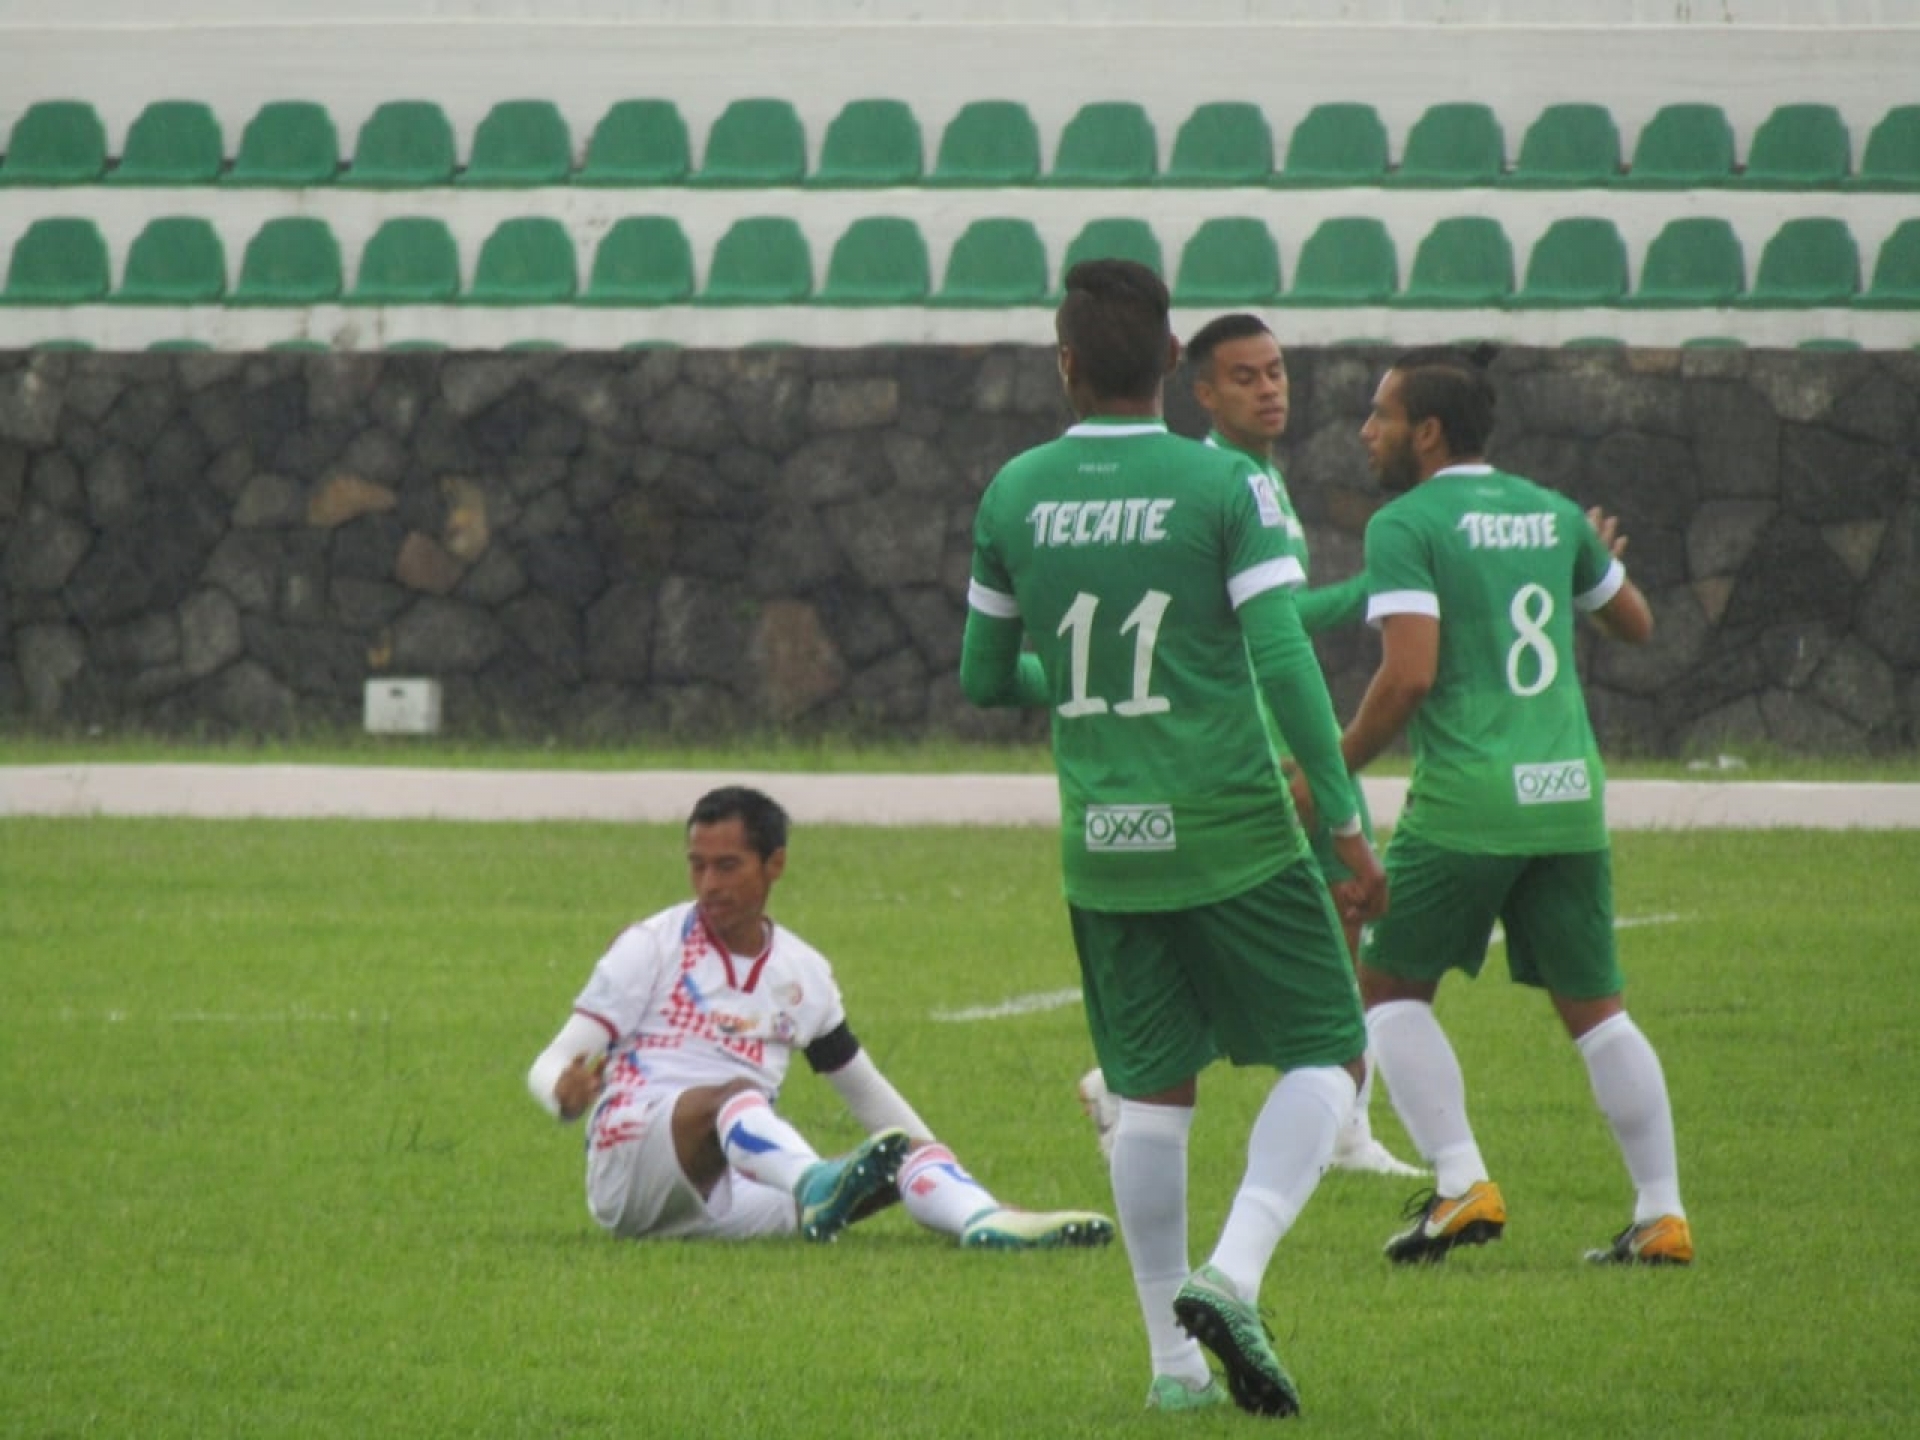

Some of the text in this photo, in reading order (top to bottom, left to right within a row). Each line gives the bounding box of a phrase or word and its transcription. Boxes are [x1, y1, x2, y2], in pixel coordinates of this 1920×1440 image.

[1026, 498, 1176, 547] TECATE
[1457, 512, 1560, 550] TECATE
[1056, 590, 1172, 718] 11
[1507, 583, 1557, 696] 8
[1518, 765, 1587, 799] OXXO
[1089, 809, 1171, 846] OXXO
